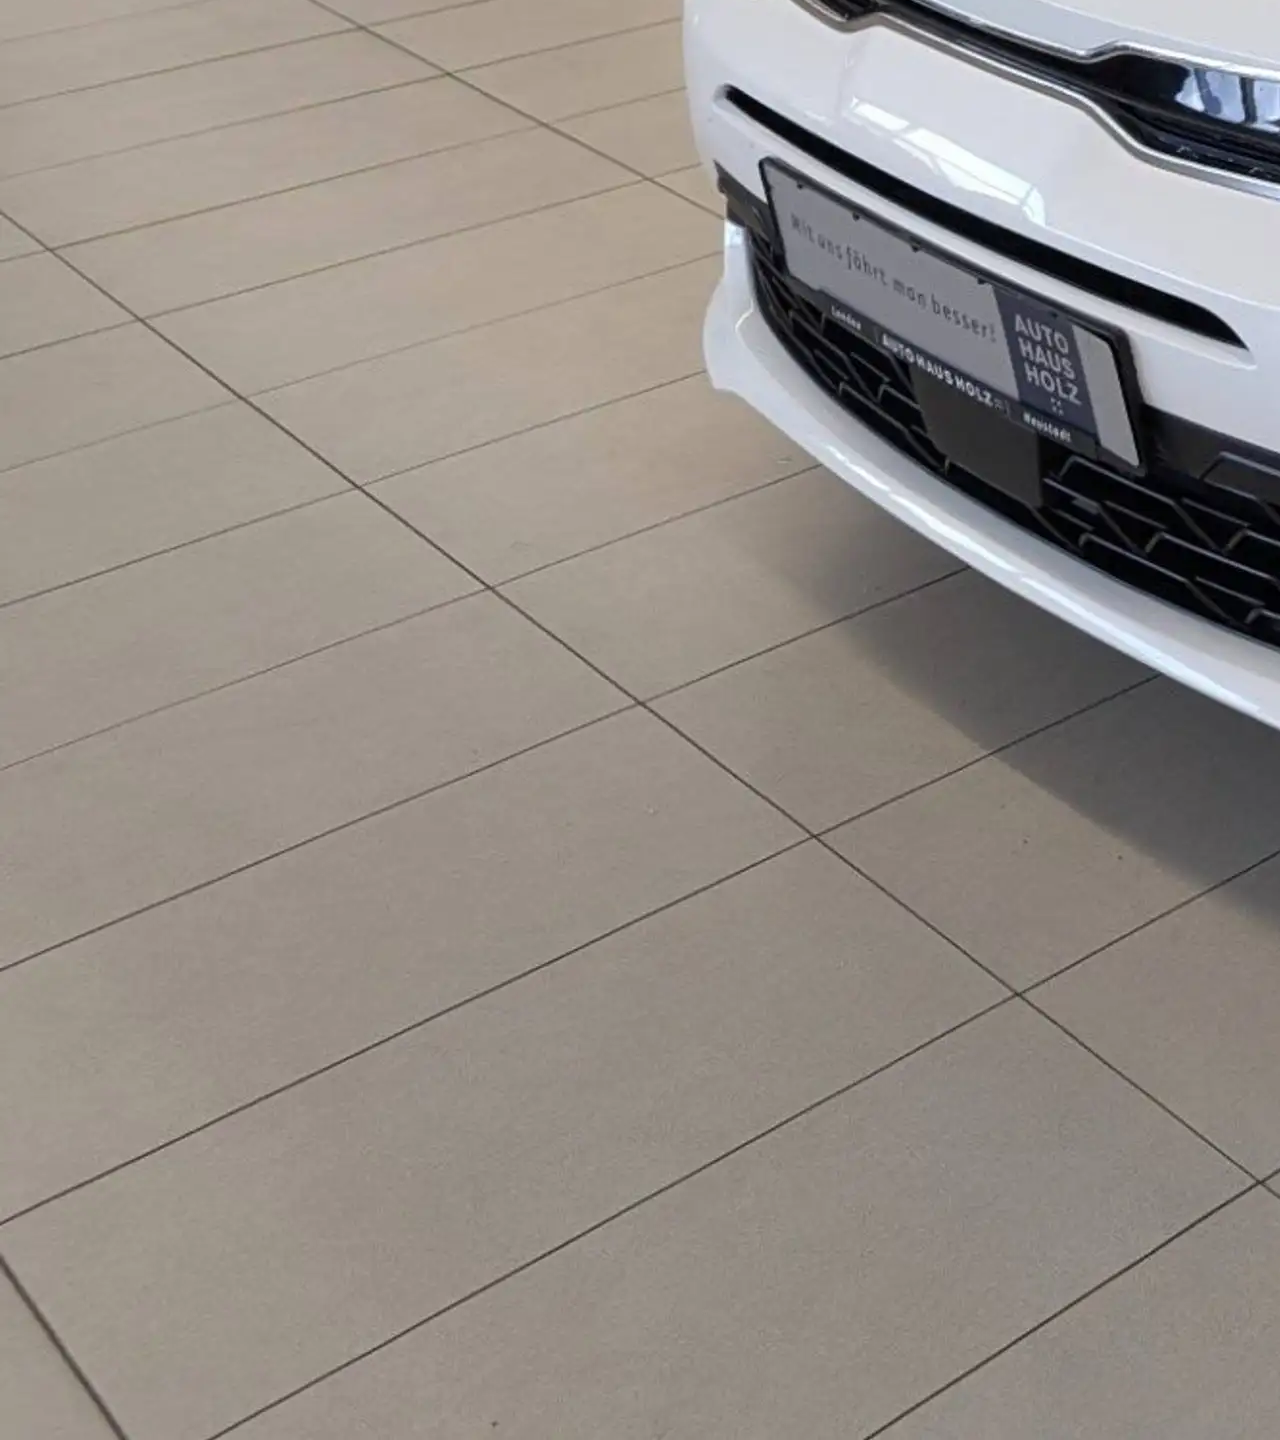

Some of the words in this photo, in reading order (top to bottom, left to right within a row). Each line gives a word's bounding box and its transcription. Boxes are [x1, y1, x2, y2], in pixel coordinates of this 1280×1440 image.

[818, 233, 843, 260] uns
[892, 277, 927, 310] man
[1014, 313, 1070, 355] AUTO
[1017, 336, 1077, 381] HAUS
[1023, 361, 1083, 407] HOLZ
